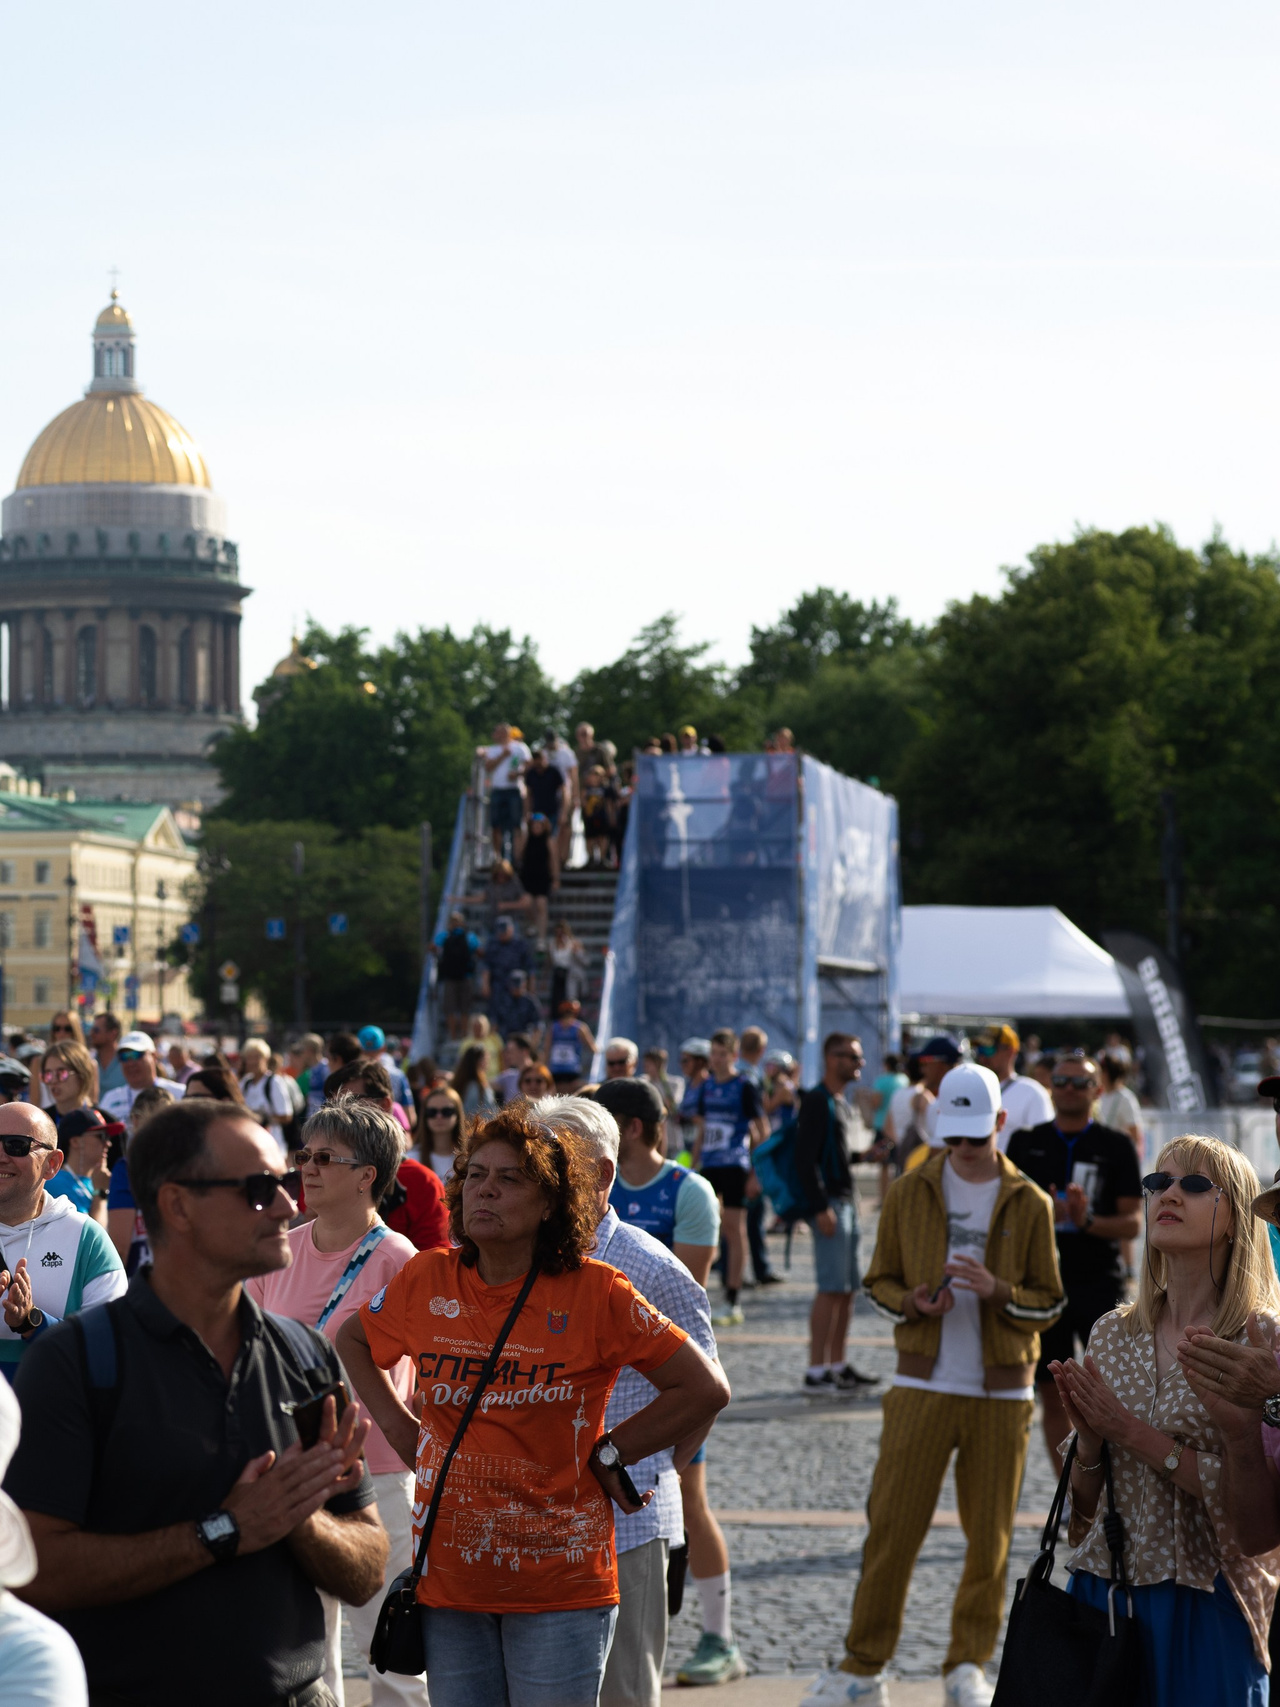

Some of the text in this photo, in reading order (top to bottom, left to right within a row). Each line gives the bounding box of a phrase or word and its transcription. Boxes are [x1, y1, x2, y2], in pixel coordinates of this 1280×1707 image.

[41, 1260, 63, 1268] Kappa
[433, 1335, 545, 1354] ВСЕРОССИЙСКИЕ СВНОВАНИЯ
[450, 1346, 461, 1354] ПО
[418, 1352, 566, 1386] СПРИНТ
[431, 1379, 575, 1414] Дврцовой
